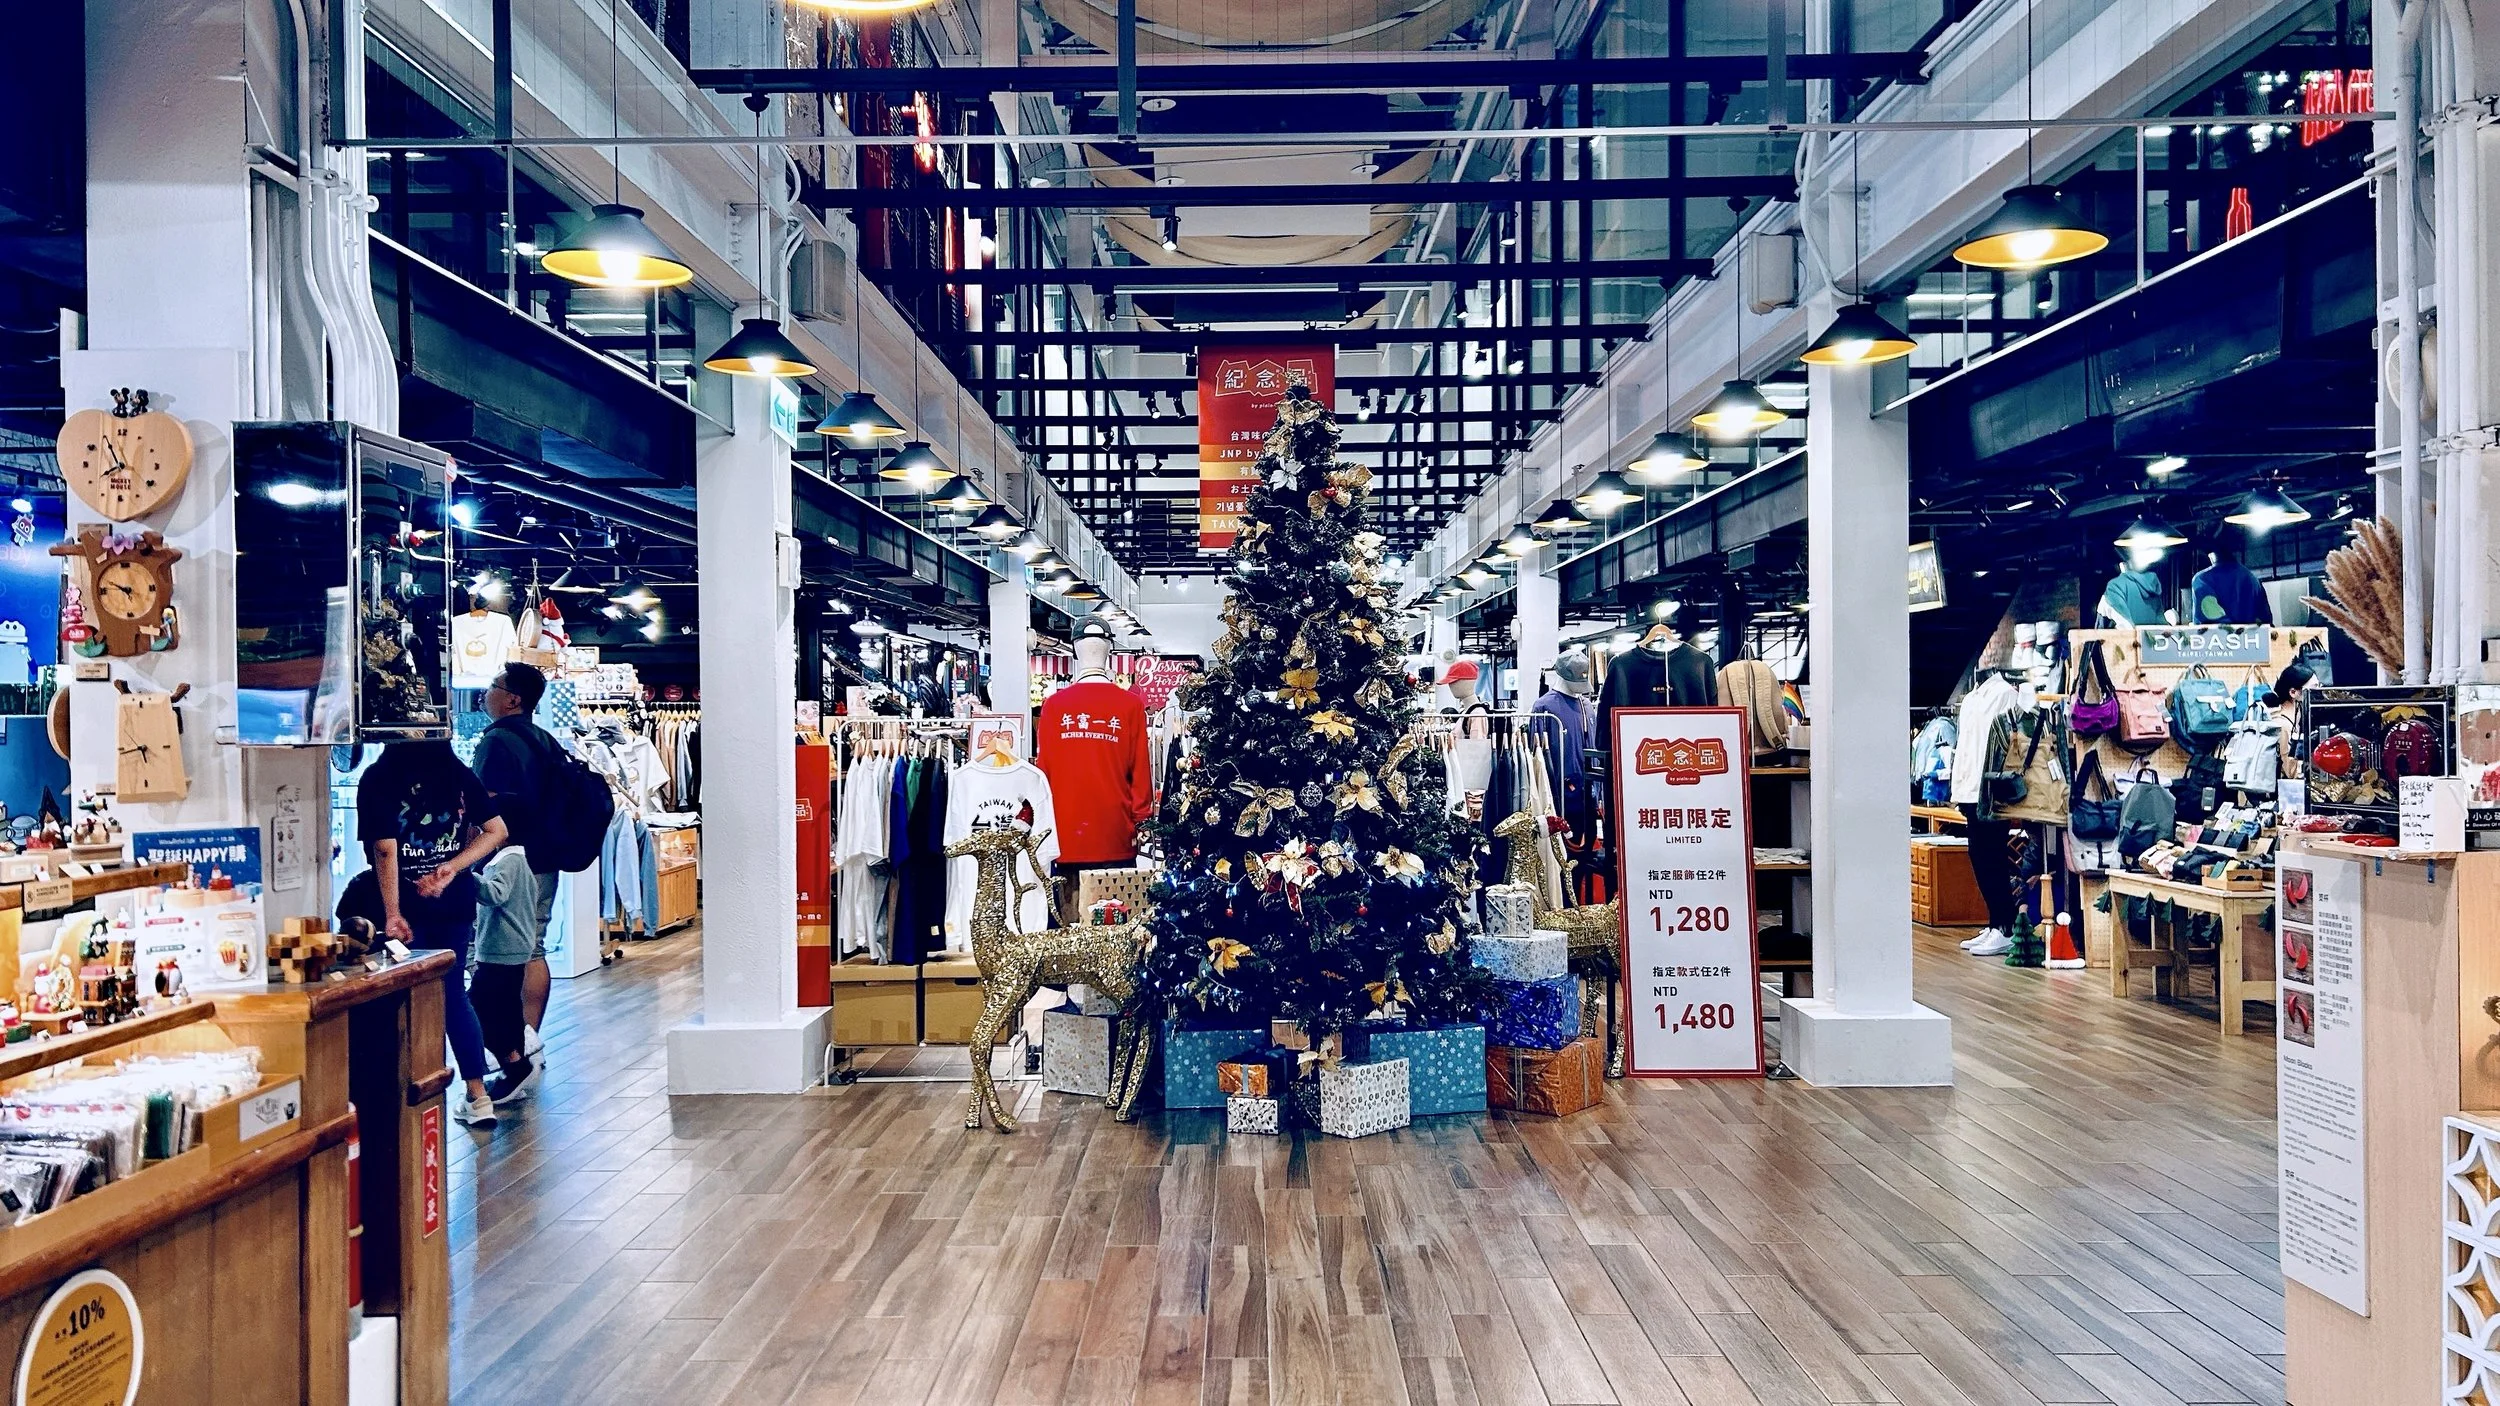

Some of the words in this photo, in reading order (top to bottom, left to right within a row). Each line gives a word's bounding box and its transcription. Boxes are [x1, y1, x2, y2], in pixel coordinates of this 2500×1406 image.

[1220, 449, 1242, 458] JNP
[1247, 449, 1260, 459] by
[2153, 632, 2260, 651] DYDASH
[1060, 713, 1122, 733] 年富一年
[1105, 734, 1119, 743] YEAR
[1647, 749, 1716, 766] 紀念品
[979, 799, 1014, 810] TAIWAN
[1638, 808, 1732, 829] 期間限定
[1666, 836, 1702, 844] LIMITED
[402, 843, 426, 856] fun
[1648, 869, 1727, 881] 指定服飾任2件
[1649, 889, 1673, 900] NTD
[1650, 906, 1730, 936] 1,280
[1652, 966, 1731, 977] 指定款式任2件
[1653, 986, 1678, 997] NTD
[1654, 1003, 1735, 1034] 1,480
[69, 1296, 105, 1336] 10%
